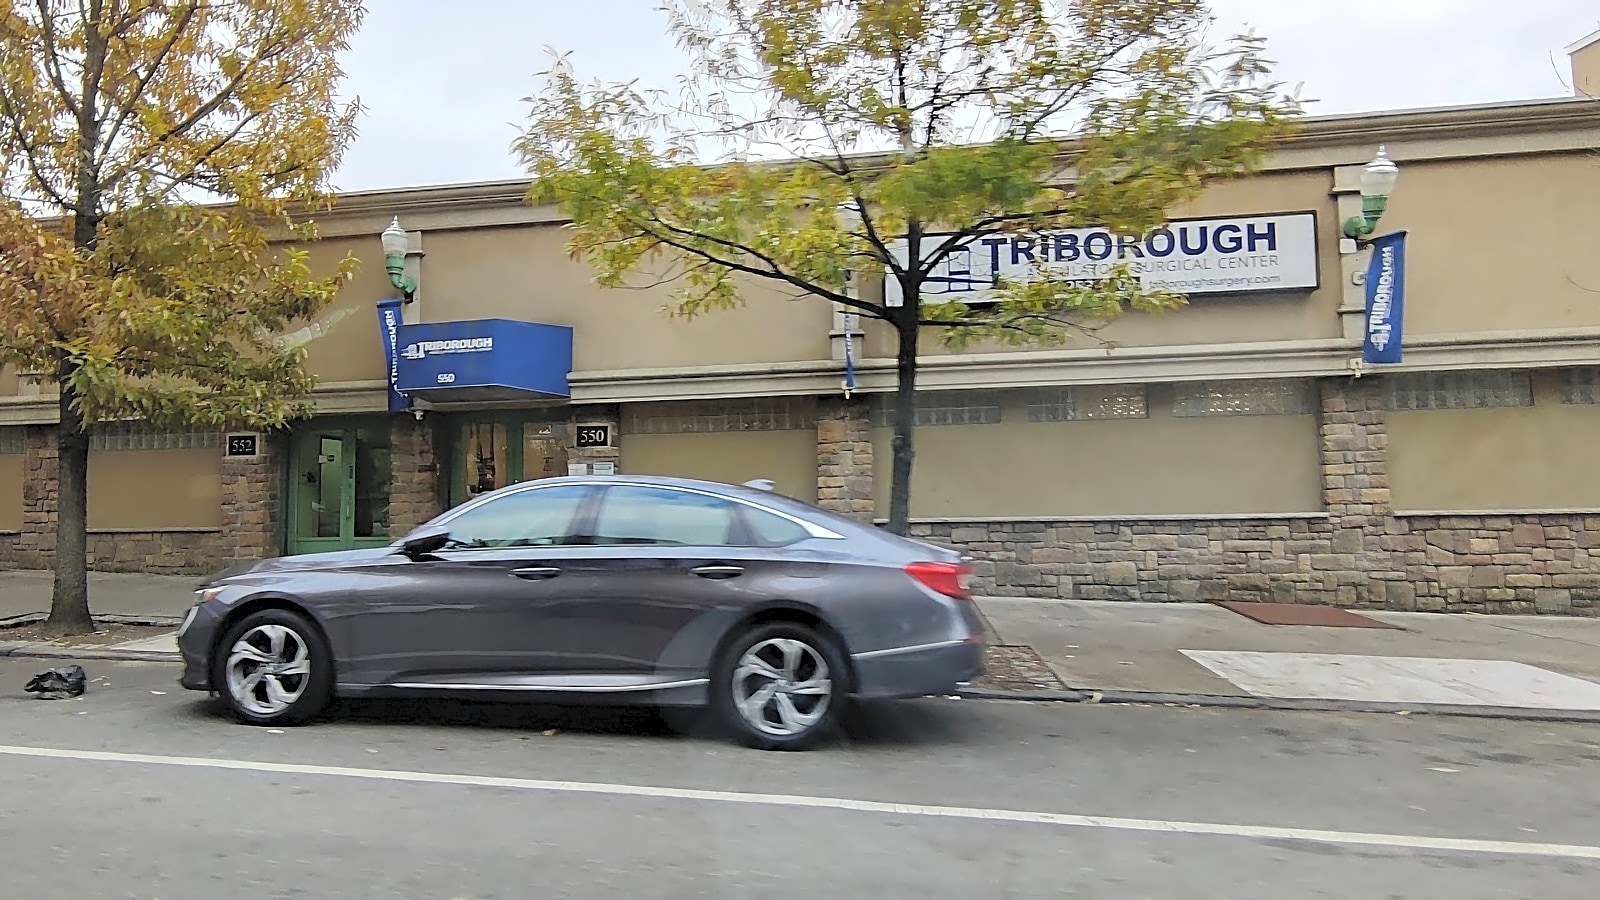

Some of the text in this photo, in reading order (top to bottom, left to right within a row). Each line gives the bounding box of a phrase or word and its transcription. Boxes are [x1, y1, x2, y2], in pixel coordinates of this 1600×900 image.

[981, 222, 1277, 284] TRIBOROUGH
[1131, 258, 1212, 274] SURGICAL
[1218, 255, 1279, 269] CENTER
[417, 337, 493, 358] TRIBOROUGH
[437, 373, 456, 383] 550
[580, 429, 605, 443] 550
[232, 439, 252, 451] 552
